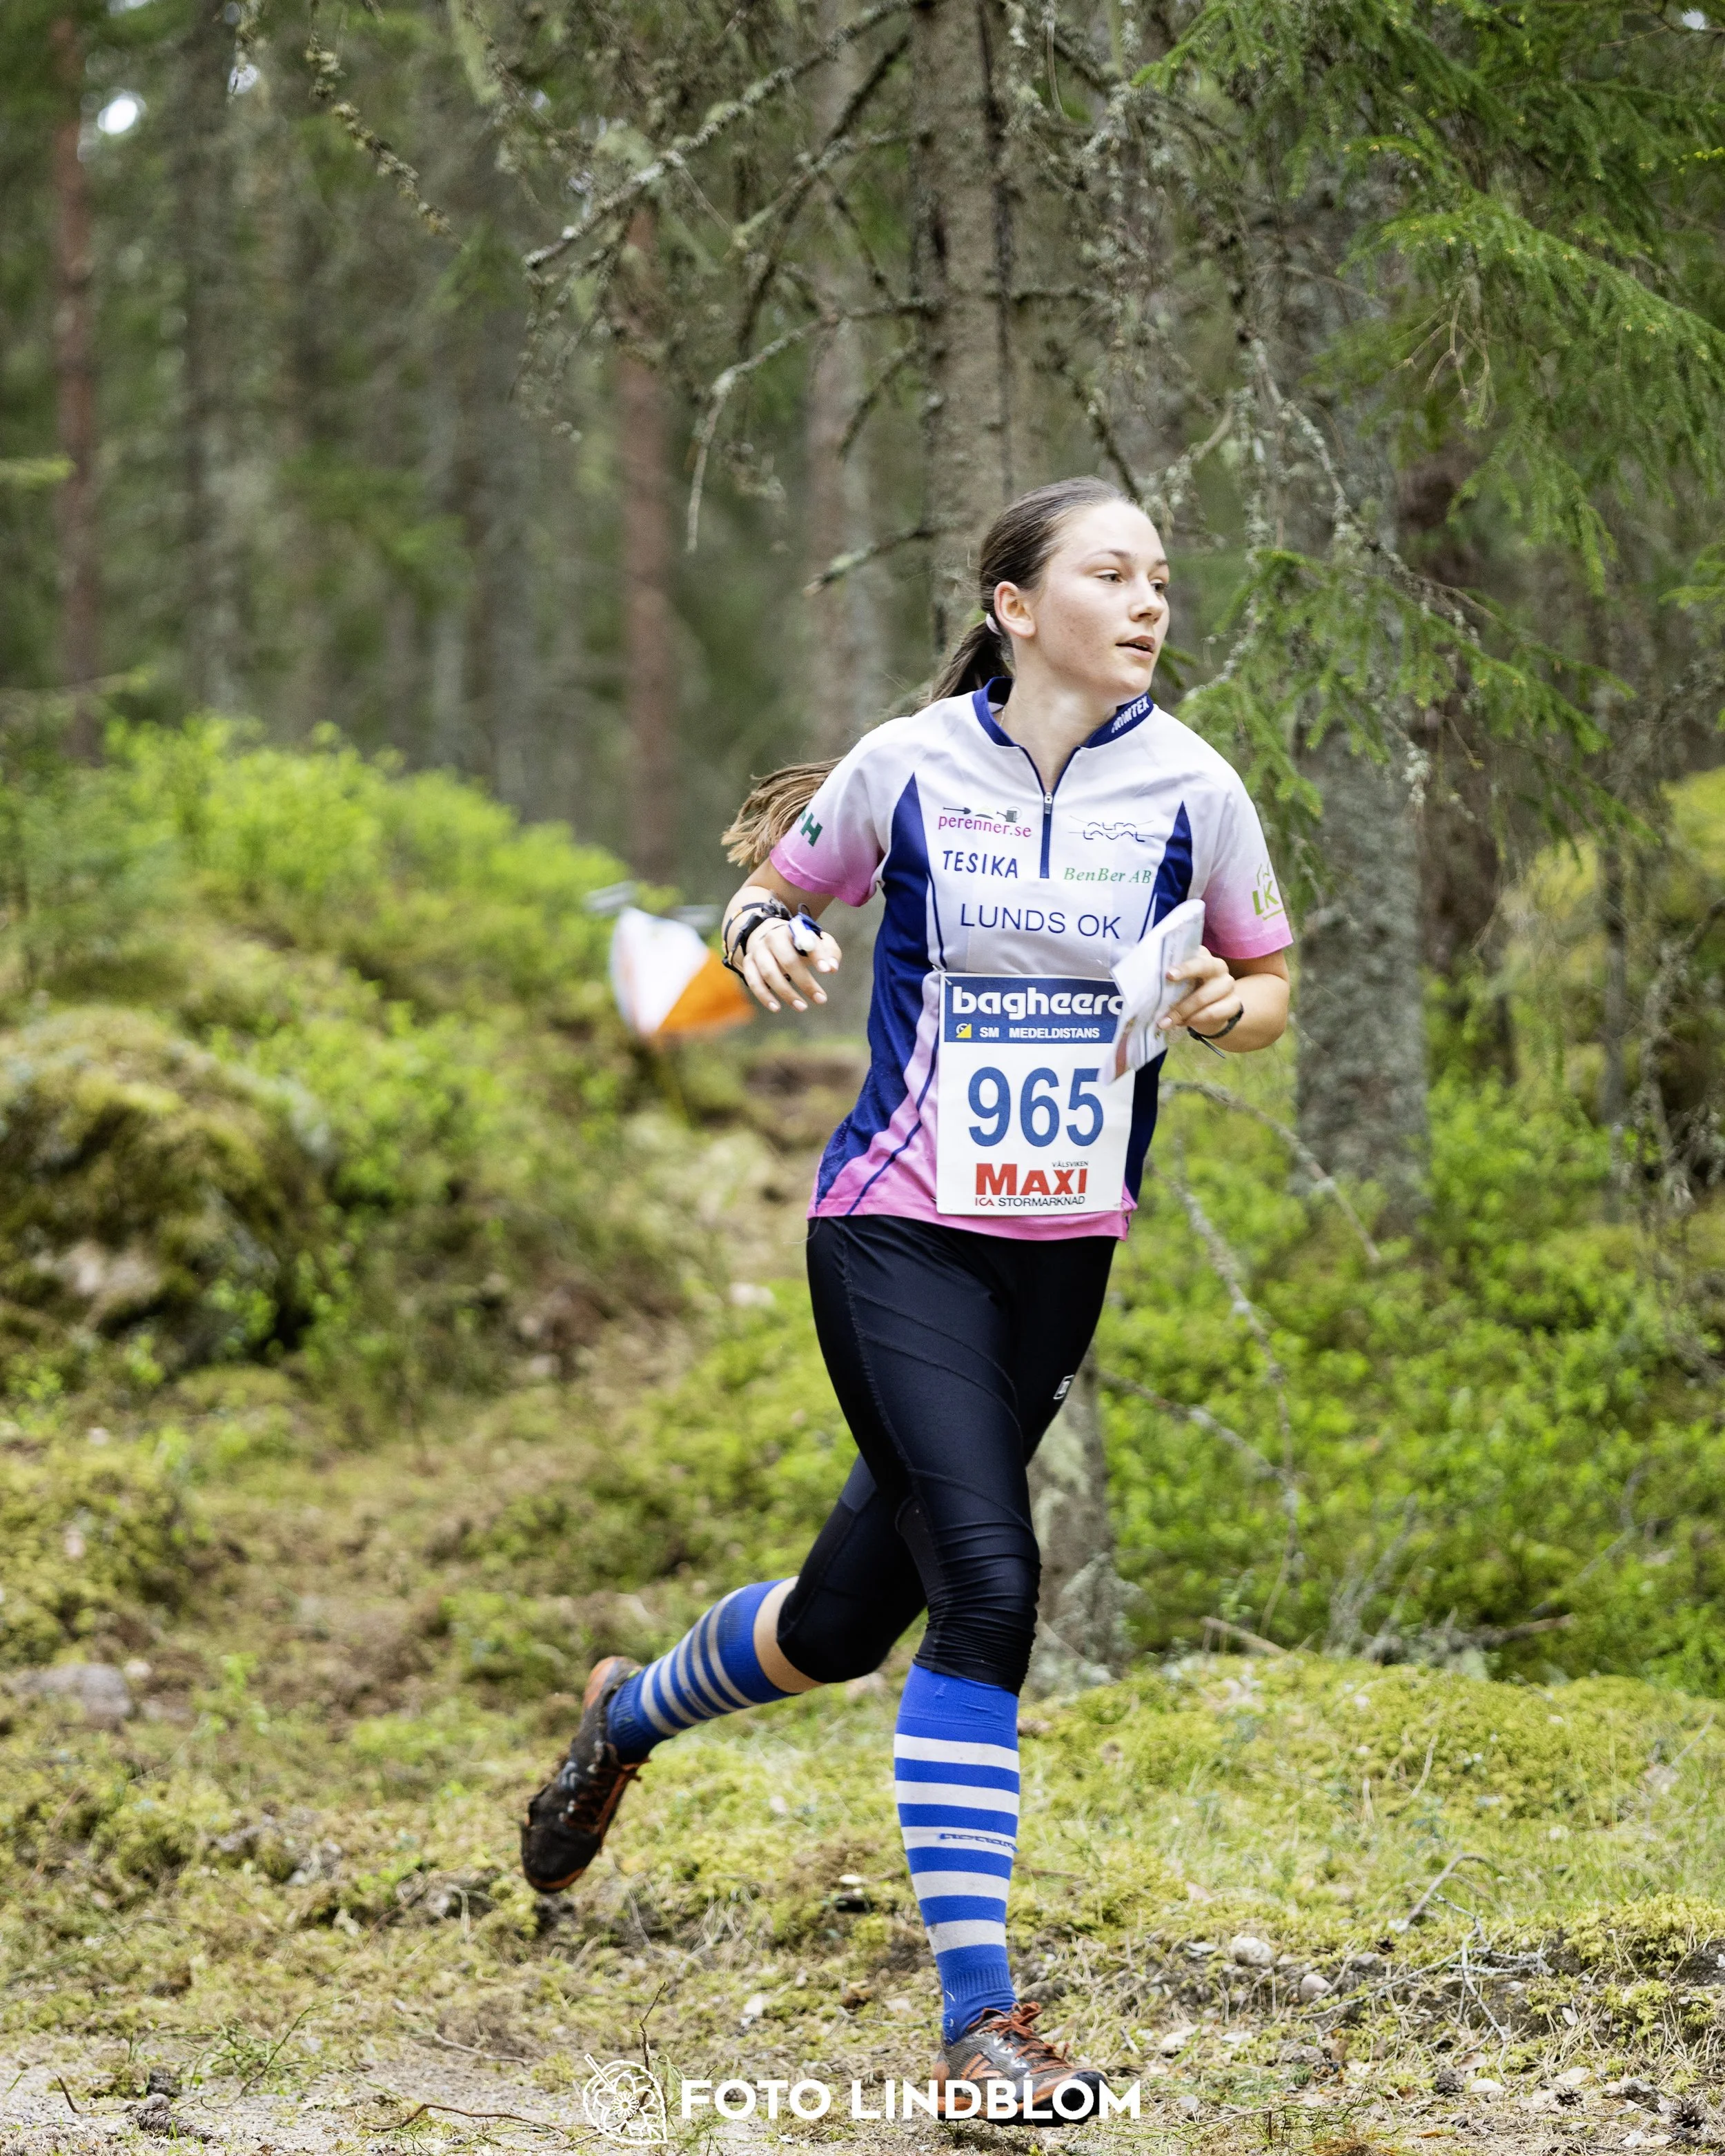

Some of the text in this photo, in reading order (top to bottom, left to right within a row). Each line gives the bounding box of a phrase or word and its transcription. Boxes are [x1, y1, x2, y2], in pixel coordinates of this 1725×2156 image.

[938, 815, 1032, 838] perenner.se
[943, 850, 1018, 878] TESIKA
[1063, 867, 1152, 884] BenBer AB
[960, 903, 1121, 939] LUNDS OK
[980, 1027, 1100, 1039] SM MEDELDISTANS
[968, 1066, 1104, 1147] 965
[976, 1163, 1088, 1196] MAXI
[975, 1196, 1085, 1207] ICA STORMARKNAD
